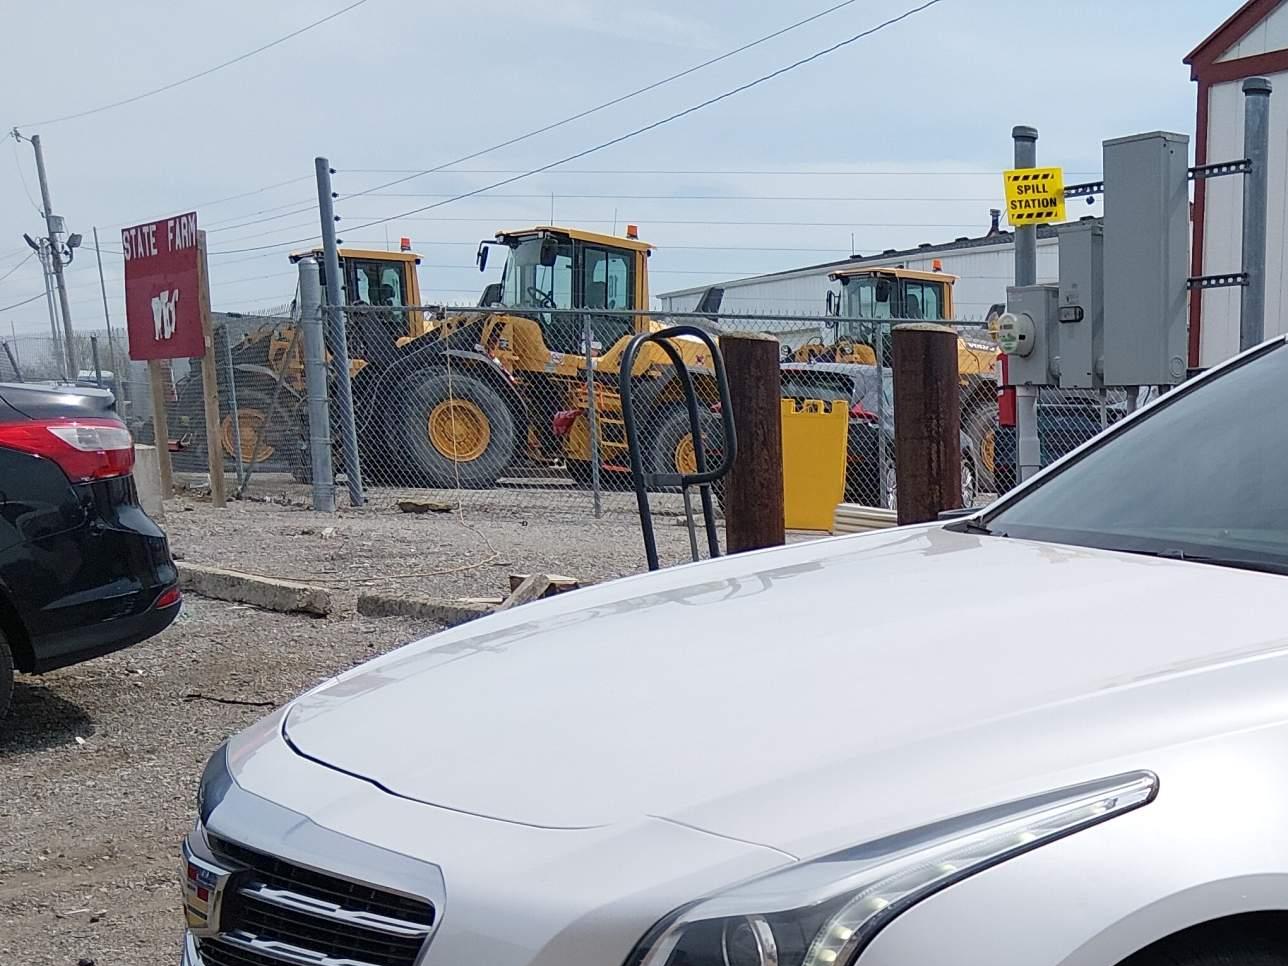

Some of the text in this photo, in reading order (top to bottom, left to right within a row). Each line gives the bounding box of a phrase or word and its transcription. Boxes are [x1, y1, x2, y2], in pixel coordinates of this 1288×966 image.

[1016, 183, 1049, 195] SPILL
[1010, 197, 1057, 210] STATION
[122, 213, 196, 261] STATE FARM
